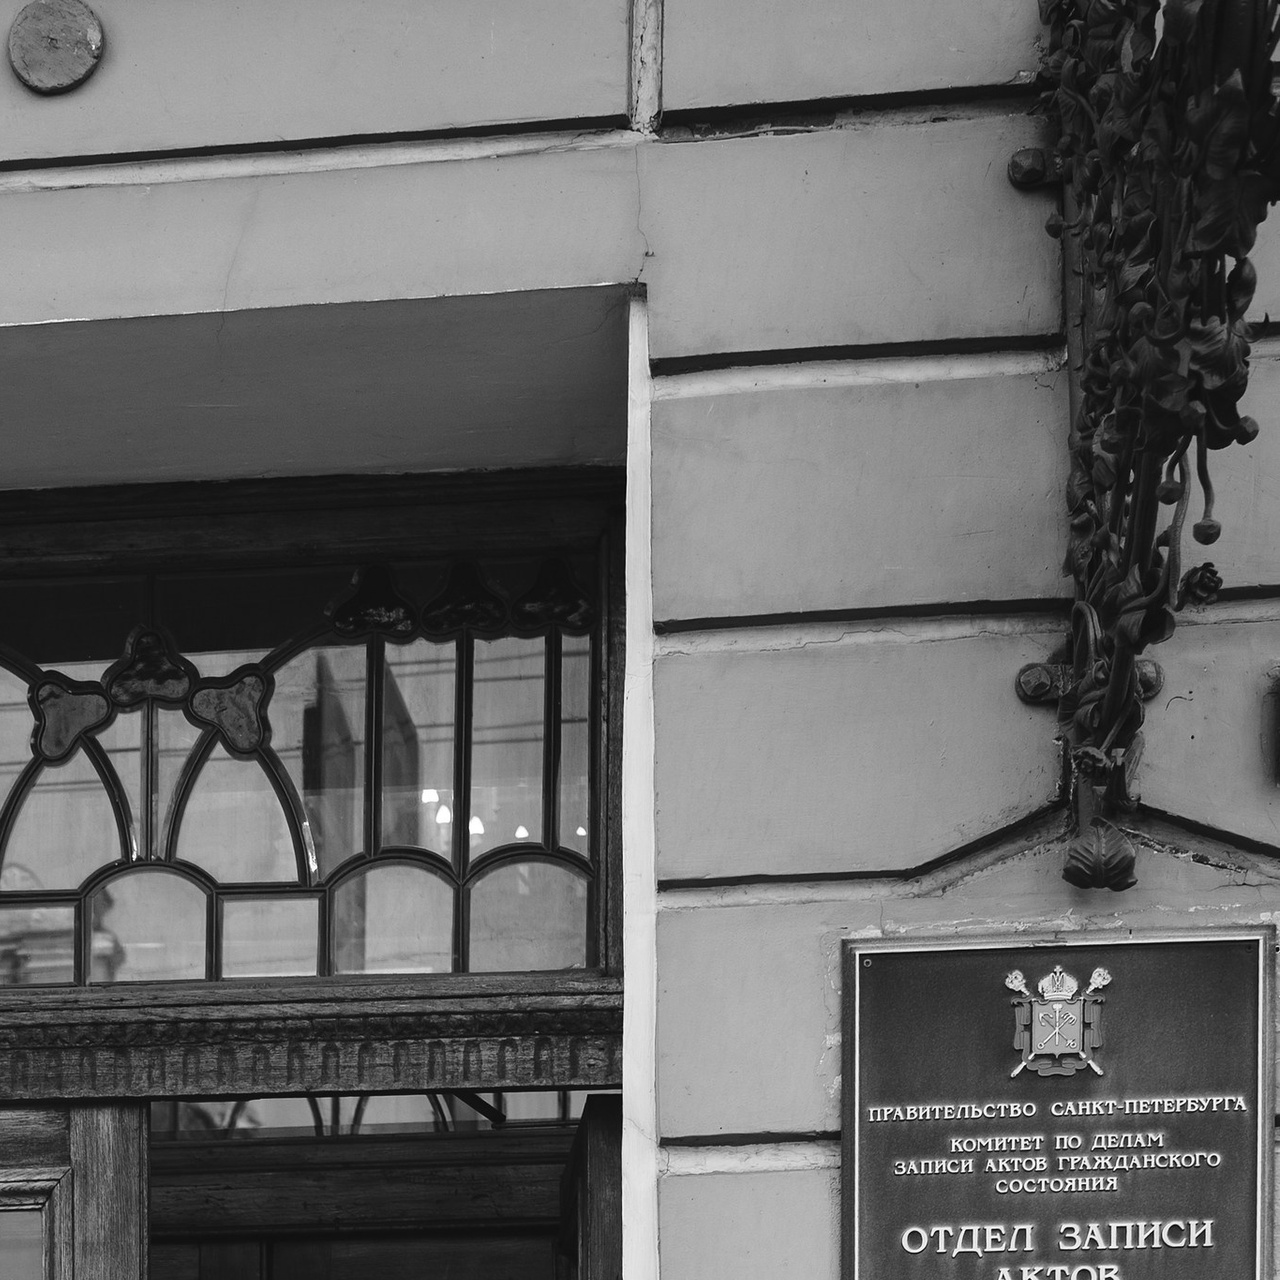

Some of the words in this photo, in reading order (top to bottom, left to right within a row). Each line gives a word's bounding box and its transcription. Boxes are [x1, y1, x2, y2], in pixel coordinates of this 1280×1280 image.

[868, 1102, 1037, 1122] ПРАВИТЕЛЬСТВО
[1051, 1095, 1248, 1116] САНКТ-ПЕТЕРБУРГА
[951, 1135, 1044, 1152] КОМИТЕТ
[1055, 1135, 1082, 1150] ПО
[1091, 1132, 1164, 1151] ДЕЛАМ
[894, 1158, 974, 1175] ЗАПИСИ
[985, 1156, 1048, 1172] АКТОВ
[1058, 1152, 1222, 1171] ГРАЖДАНСКОГО
[995, 1176, 1118, 1193] СОСТОЯНИЯ
[901, 1223, 1035, 1258] ОТДЕЛ
[1059, 1219, 1214, 1250] ЗАПИСИ
